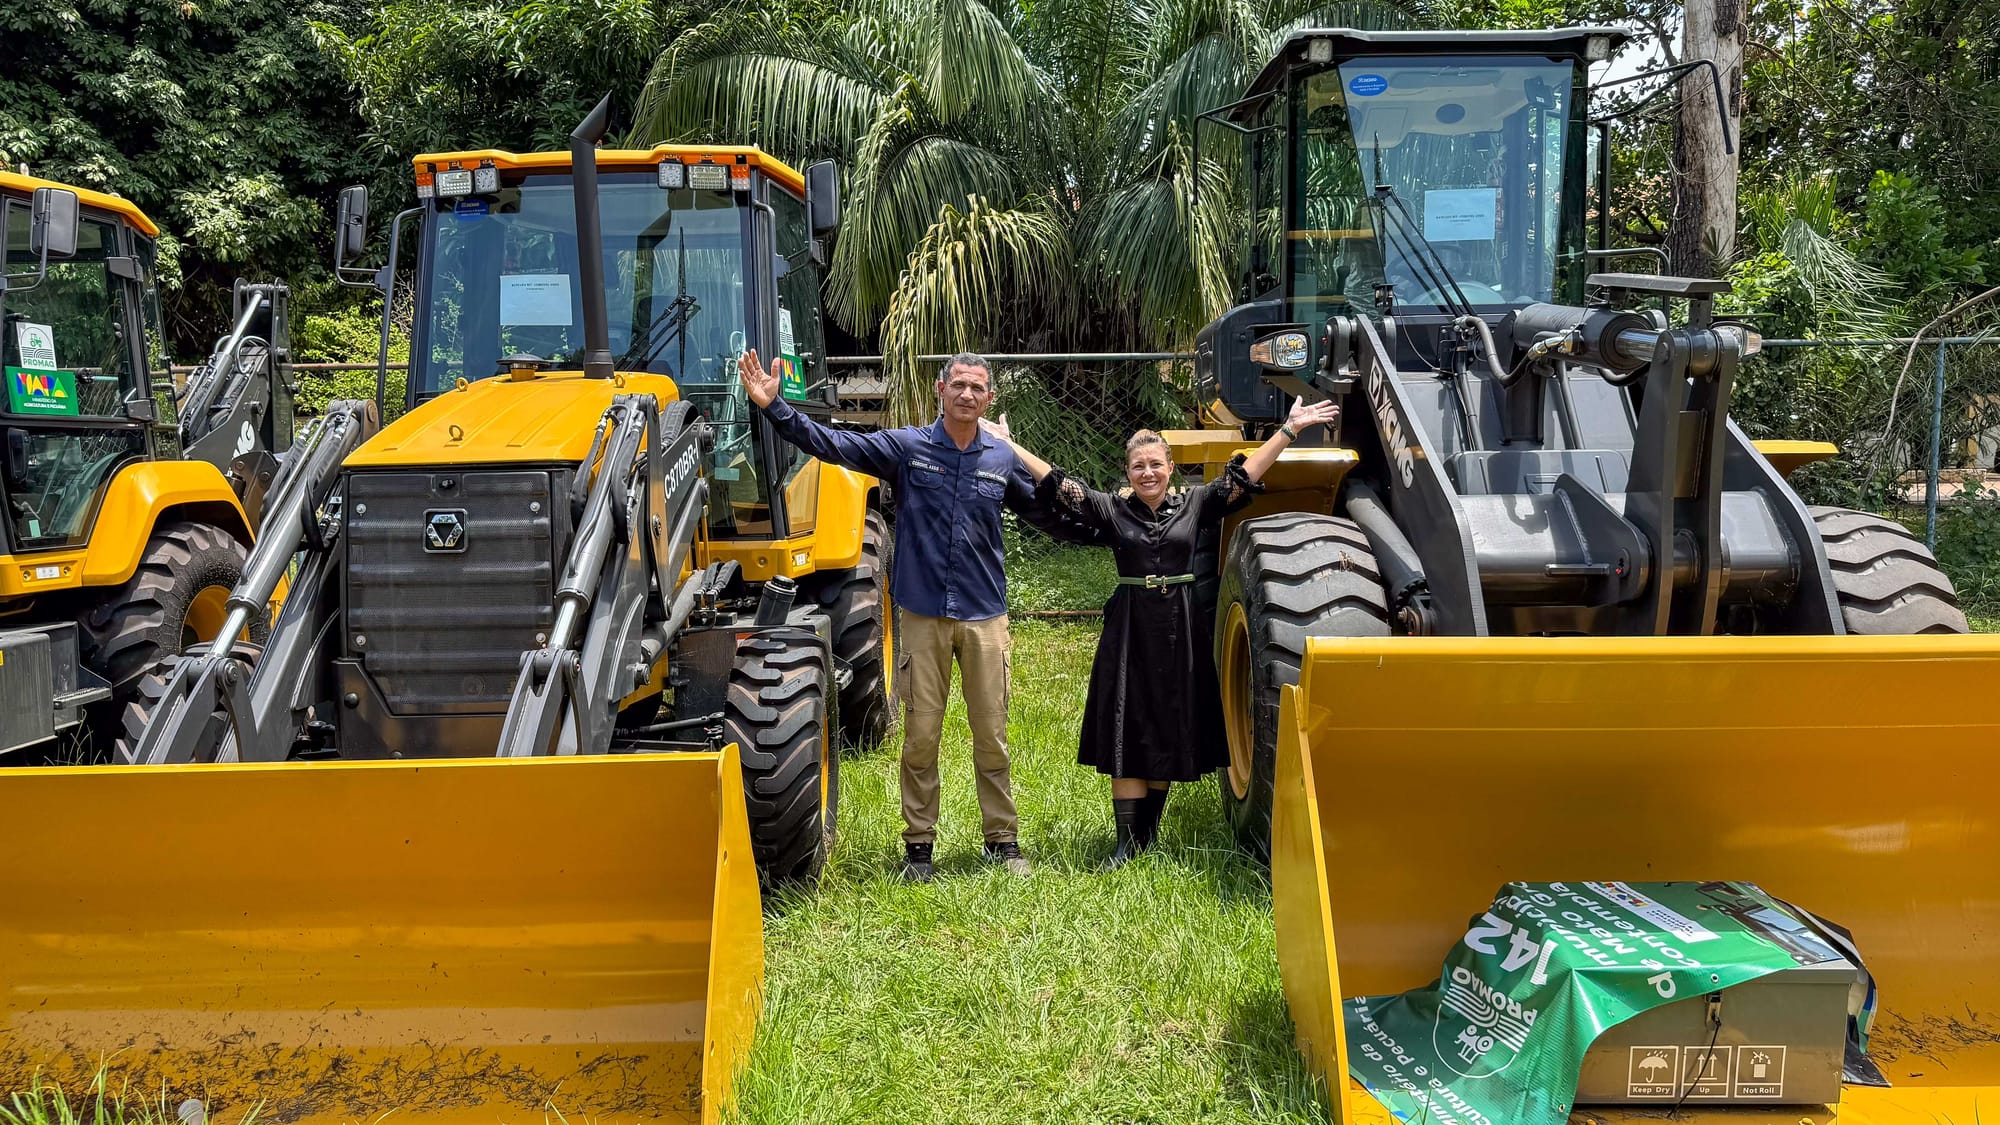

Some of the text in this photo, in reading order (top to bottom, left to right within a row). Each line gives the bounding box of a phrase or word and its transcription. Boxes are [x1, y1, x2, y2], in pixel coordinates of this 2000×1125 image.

[23, 358, 55, 368] PROMAQ
[15, 373, 69, 398] MAPA
[1376, 385, 1415, 489] XCMG
[664, 437, 699, 503] C870BR-I
[1550, 882, 1700, 968] contempla
[1561, 911, 1639, 955] Mato
[1464, 912, 1559, 985] 142
[1451, 965, 1538, 1027] PROMAQ
[1360, 1043, 1384, 1062] da
[1414, 1065, 1428, 1076] e
[1632, 1086, 1671, 1094] Keep Dry
